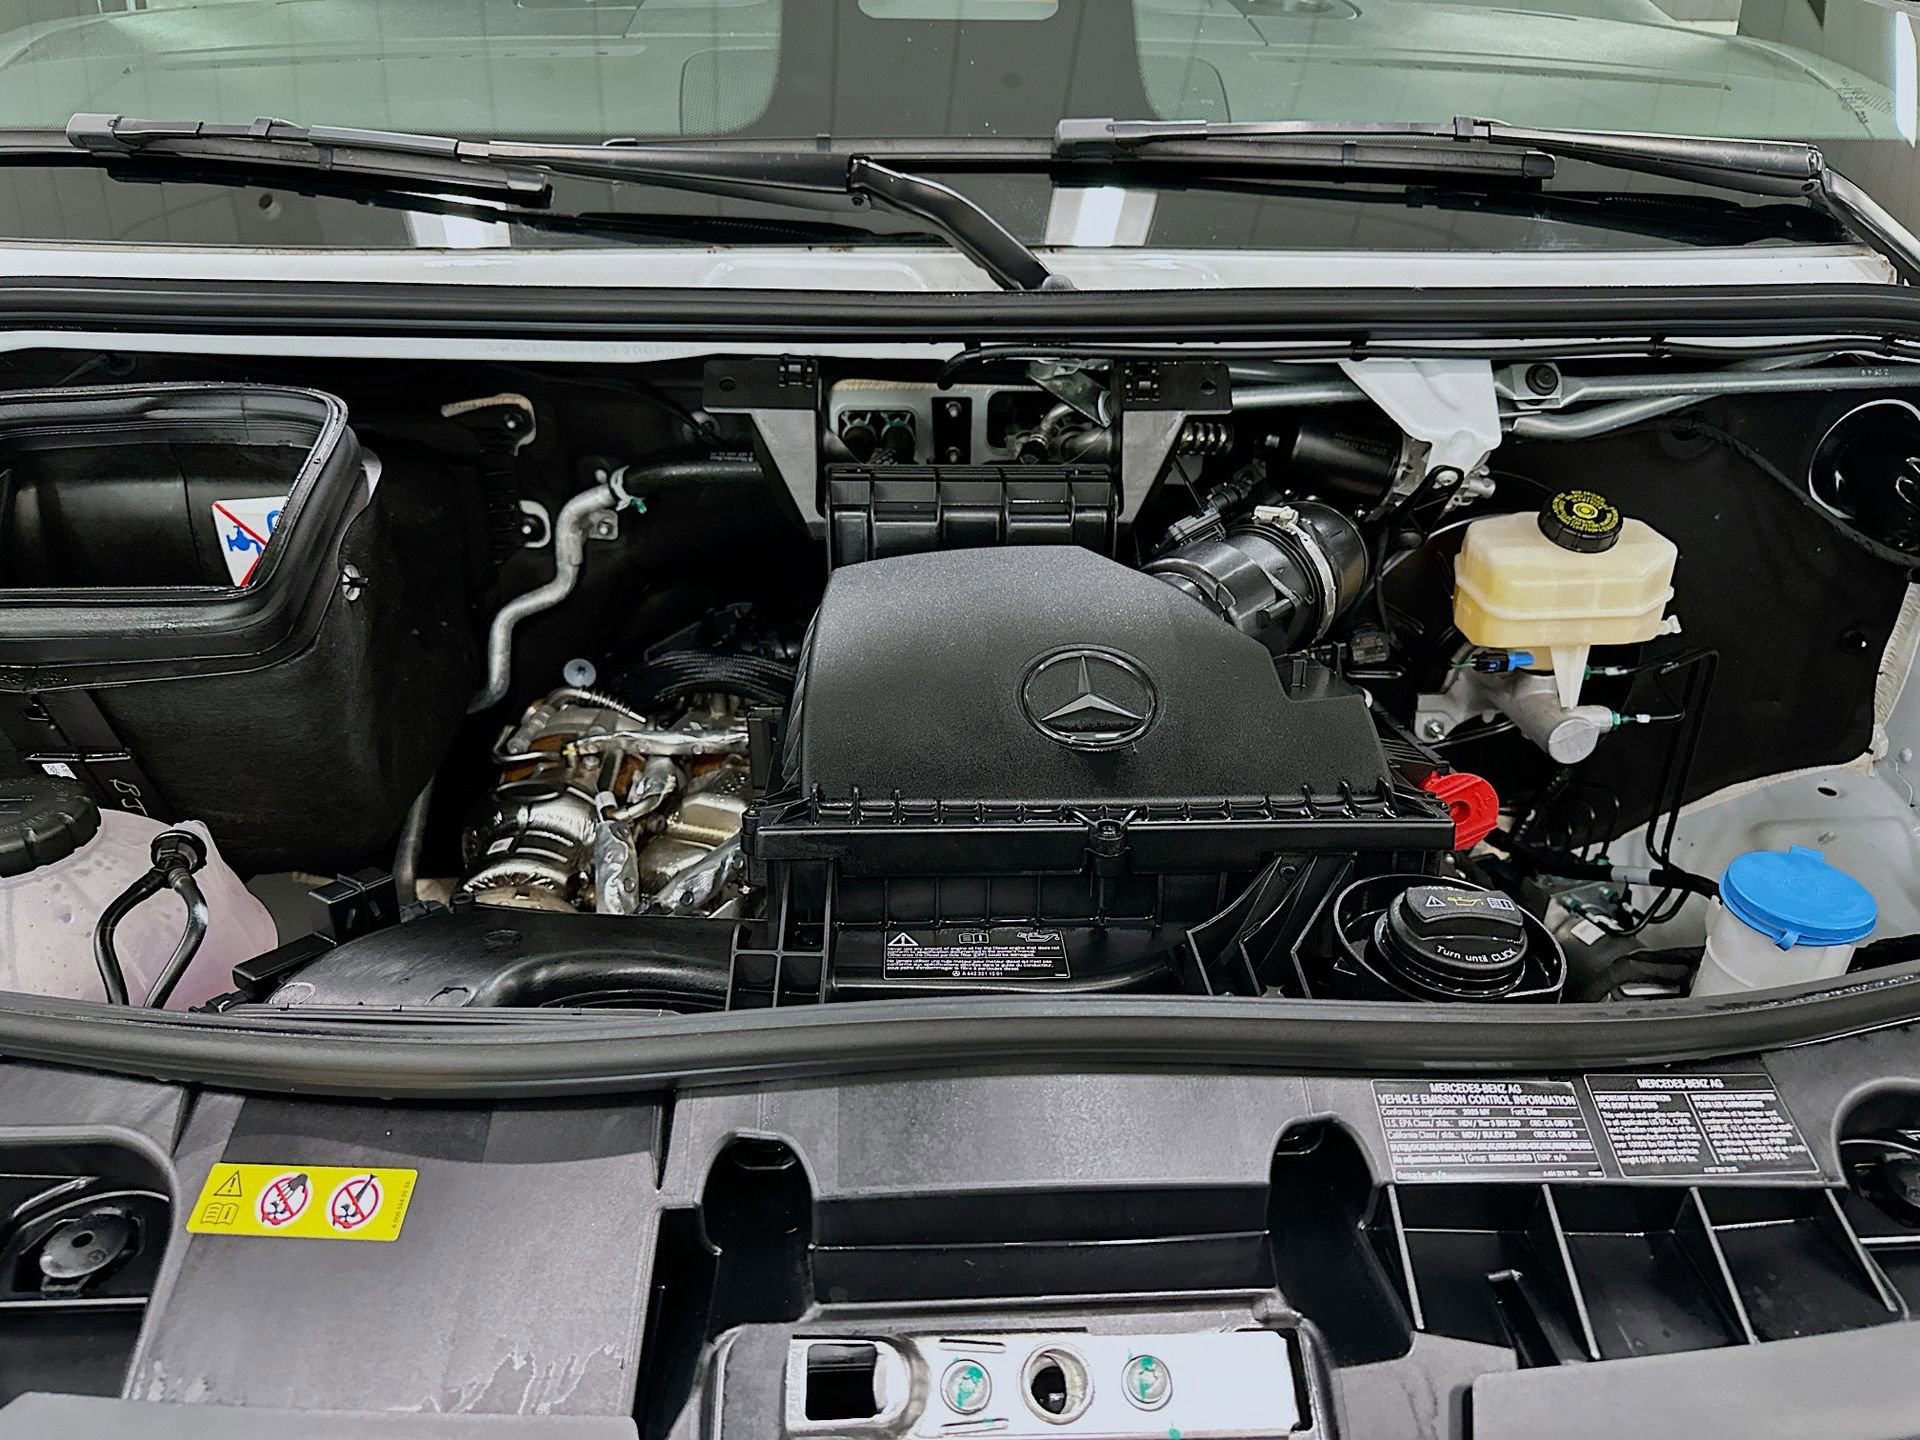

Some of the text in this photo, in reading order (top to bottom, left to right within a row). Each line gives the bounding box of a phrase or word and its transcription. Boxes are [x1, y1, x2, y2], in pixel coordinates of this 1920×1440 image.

[1436, 945, 1518, 963] Turn until CLICK
[1430, 1083, 1522, 1094] MERCEDES-BENZ AG
[1637, 1079, 1724, 1088] MERCEDES-BENZ AG
[1378, 1094, 1576, 1105] VEHICLE EMISSION CONTROL INFORMATION
